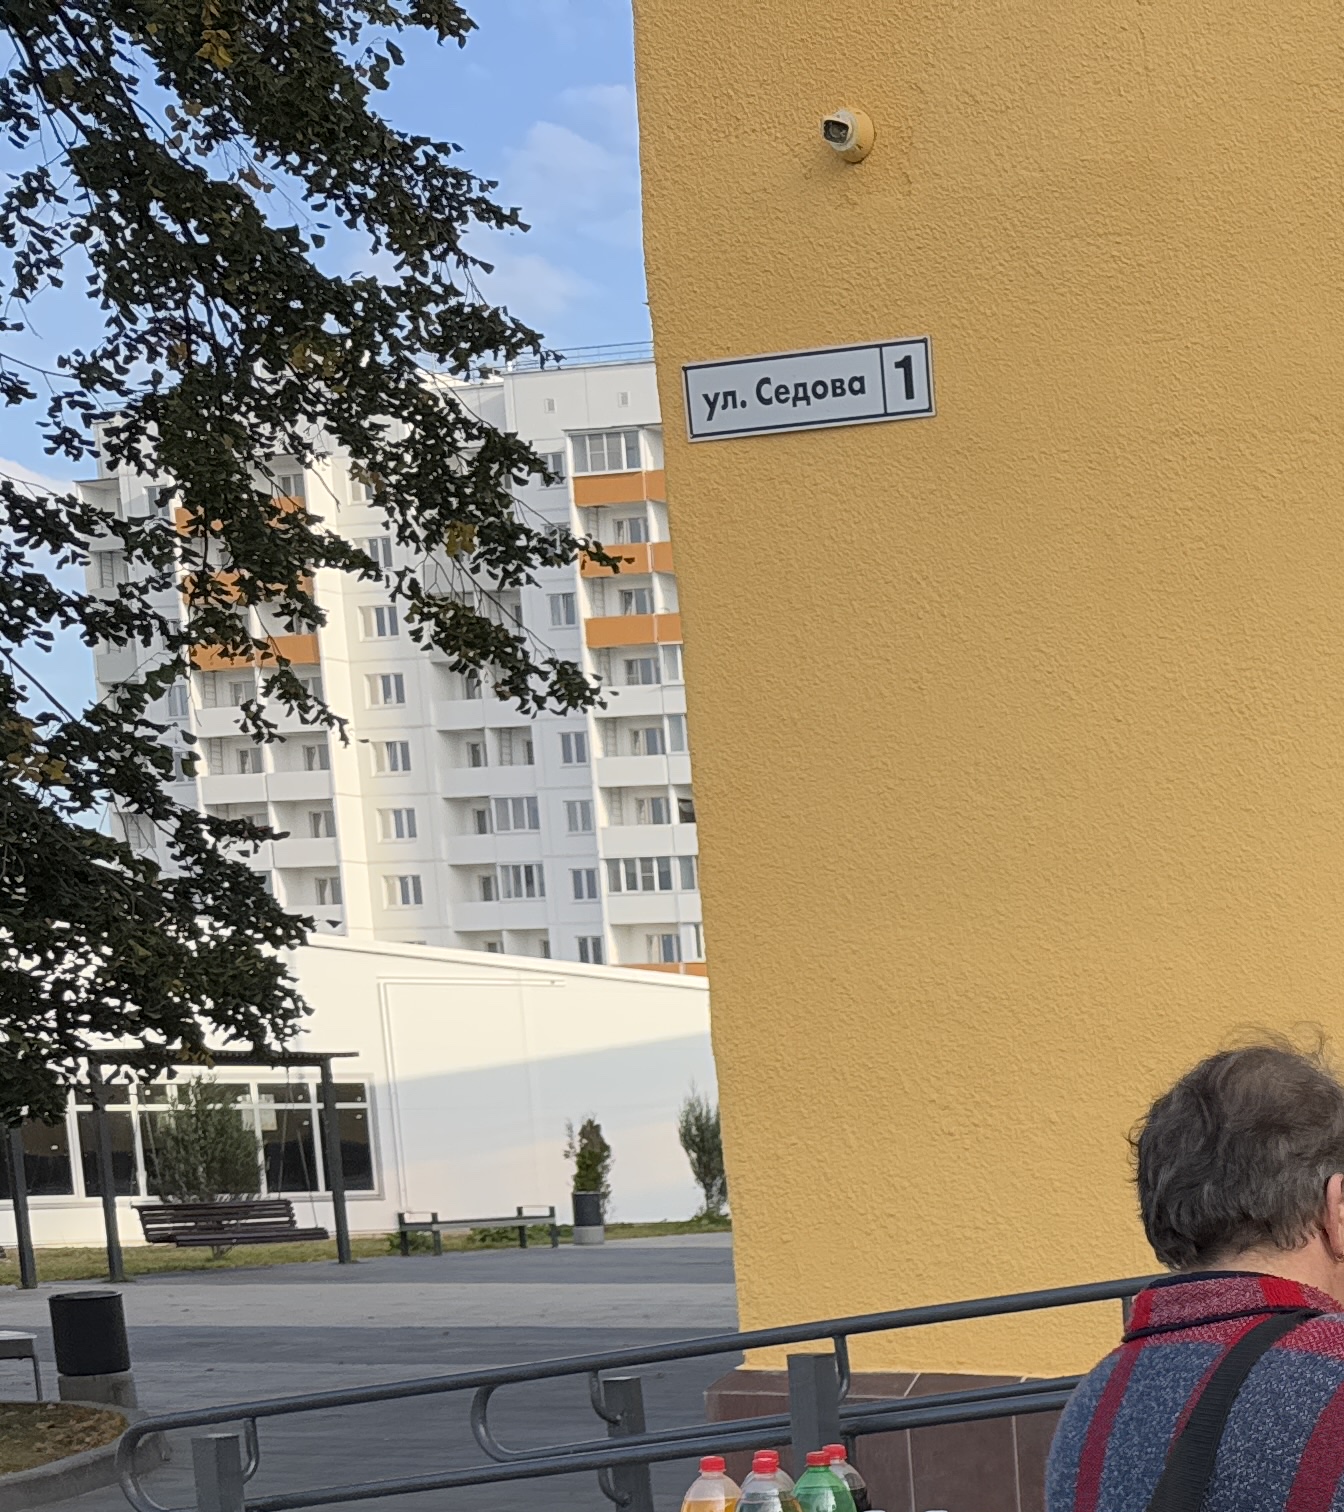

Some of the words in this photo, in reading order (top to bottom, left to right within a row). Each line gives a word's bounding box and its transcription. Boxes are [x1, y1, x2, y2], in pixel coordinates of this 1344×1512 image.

[702, 389, 747, 421] ул.
[755, 374, 866, 408] Седова
[893, 354, 915, 400] 1
